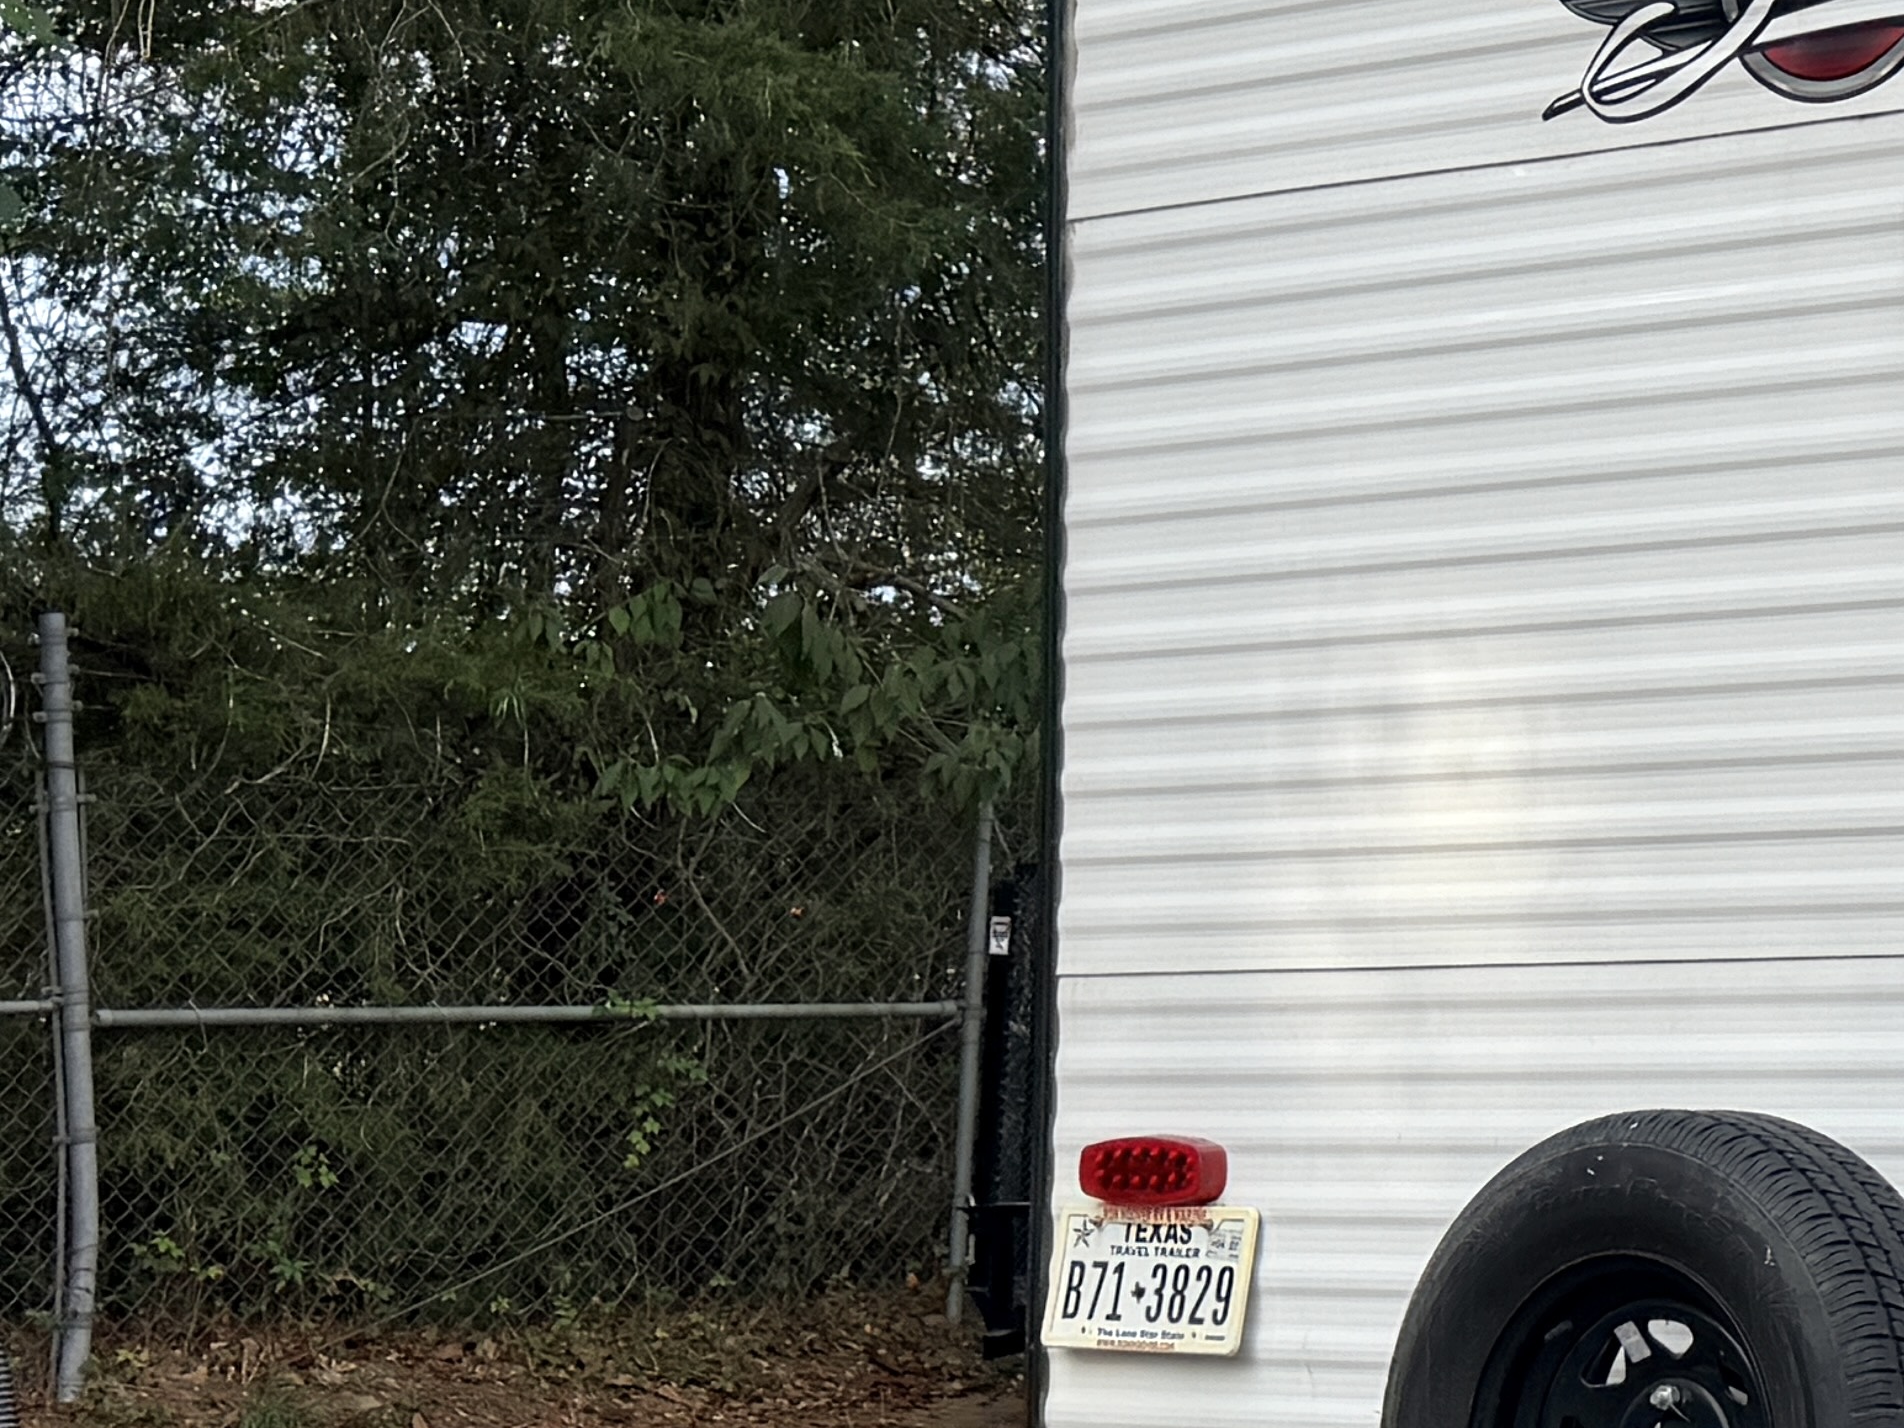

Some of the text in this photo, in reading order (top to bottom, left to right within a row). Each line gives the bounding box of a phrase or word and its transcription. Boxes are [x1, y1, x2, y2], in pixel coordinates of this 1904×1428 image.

[1124, 1222, 1193, 1245] TEXAS
[1110, 1245, 1201, 1259] TRAVEL TRAILER
[1061, 1260, 1236, 1326] B71 3829
[1097, 1327, 1113, 1337] The
[1115, 1328, 1138, 1338] Lone
